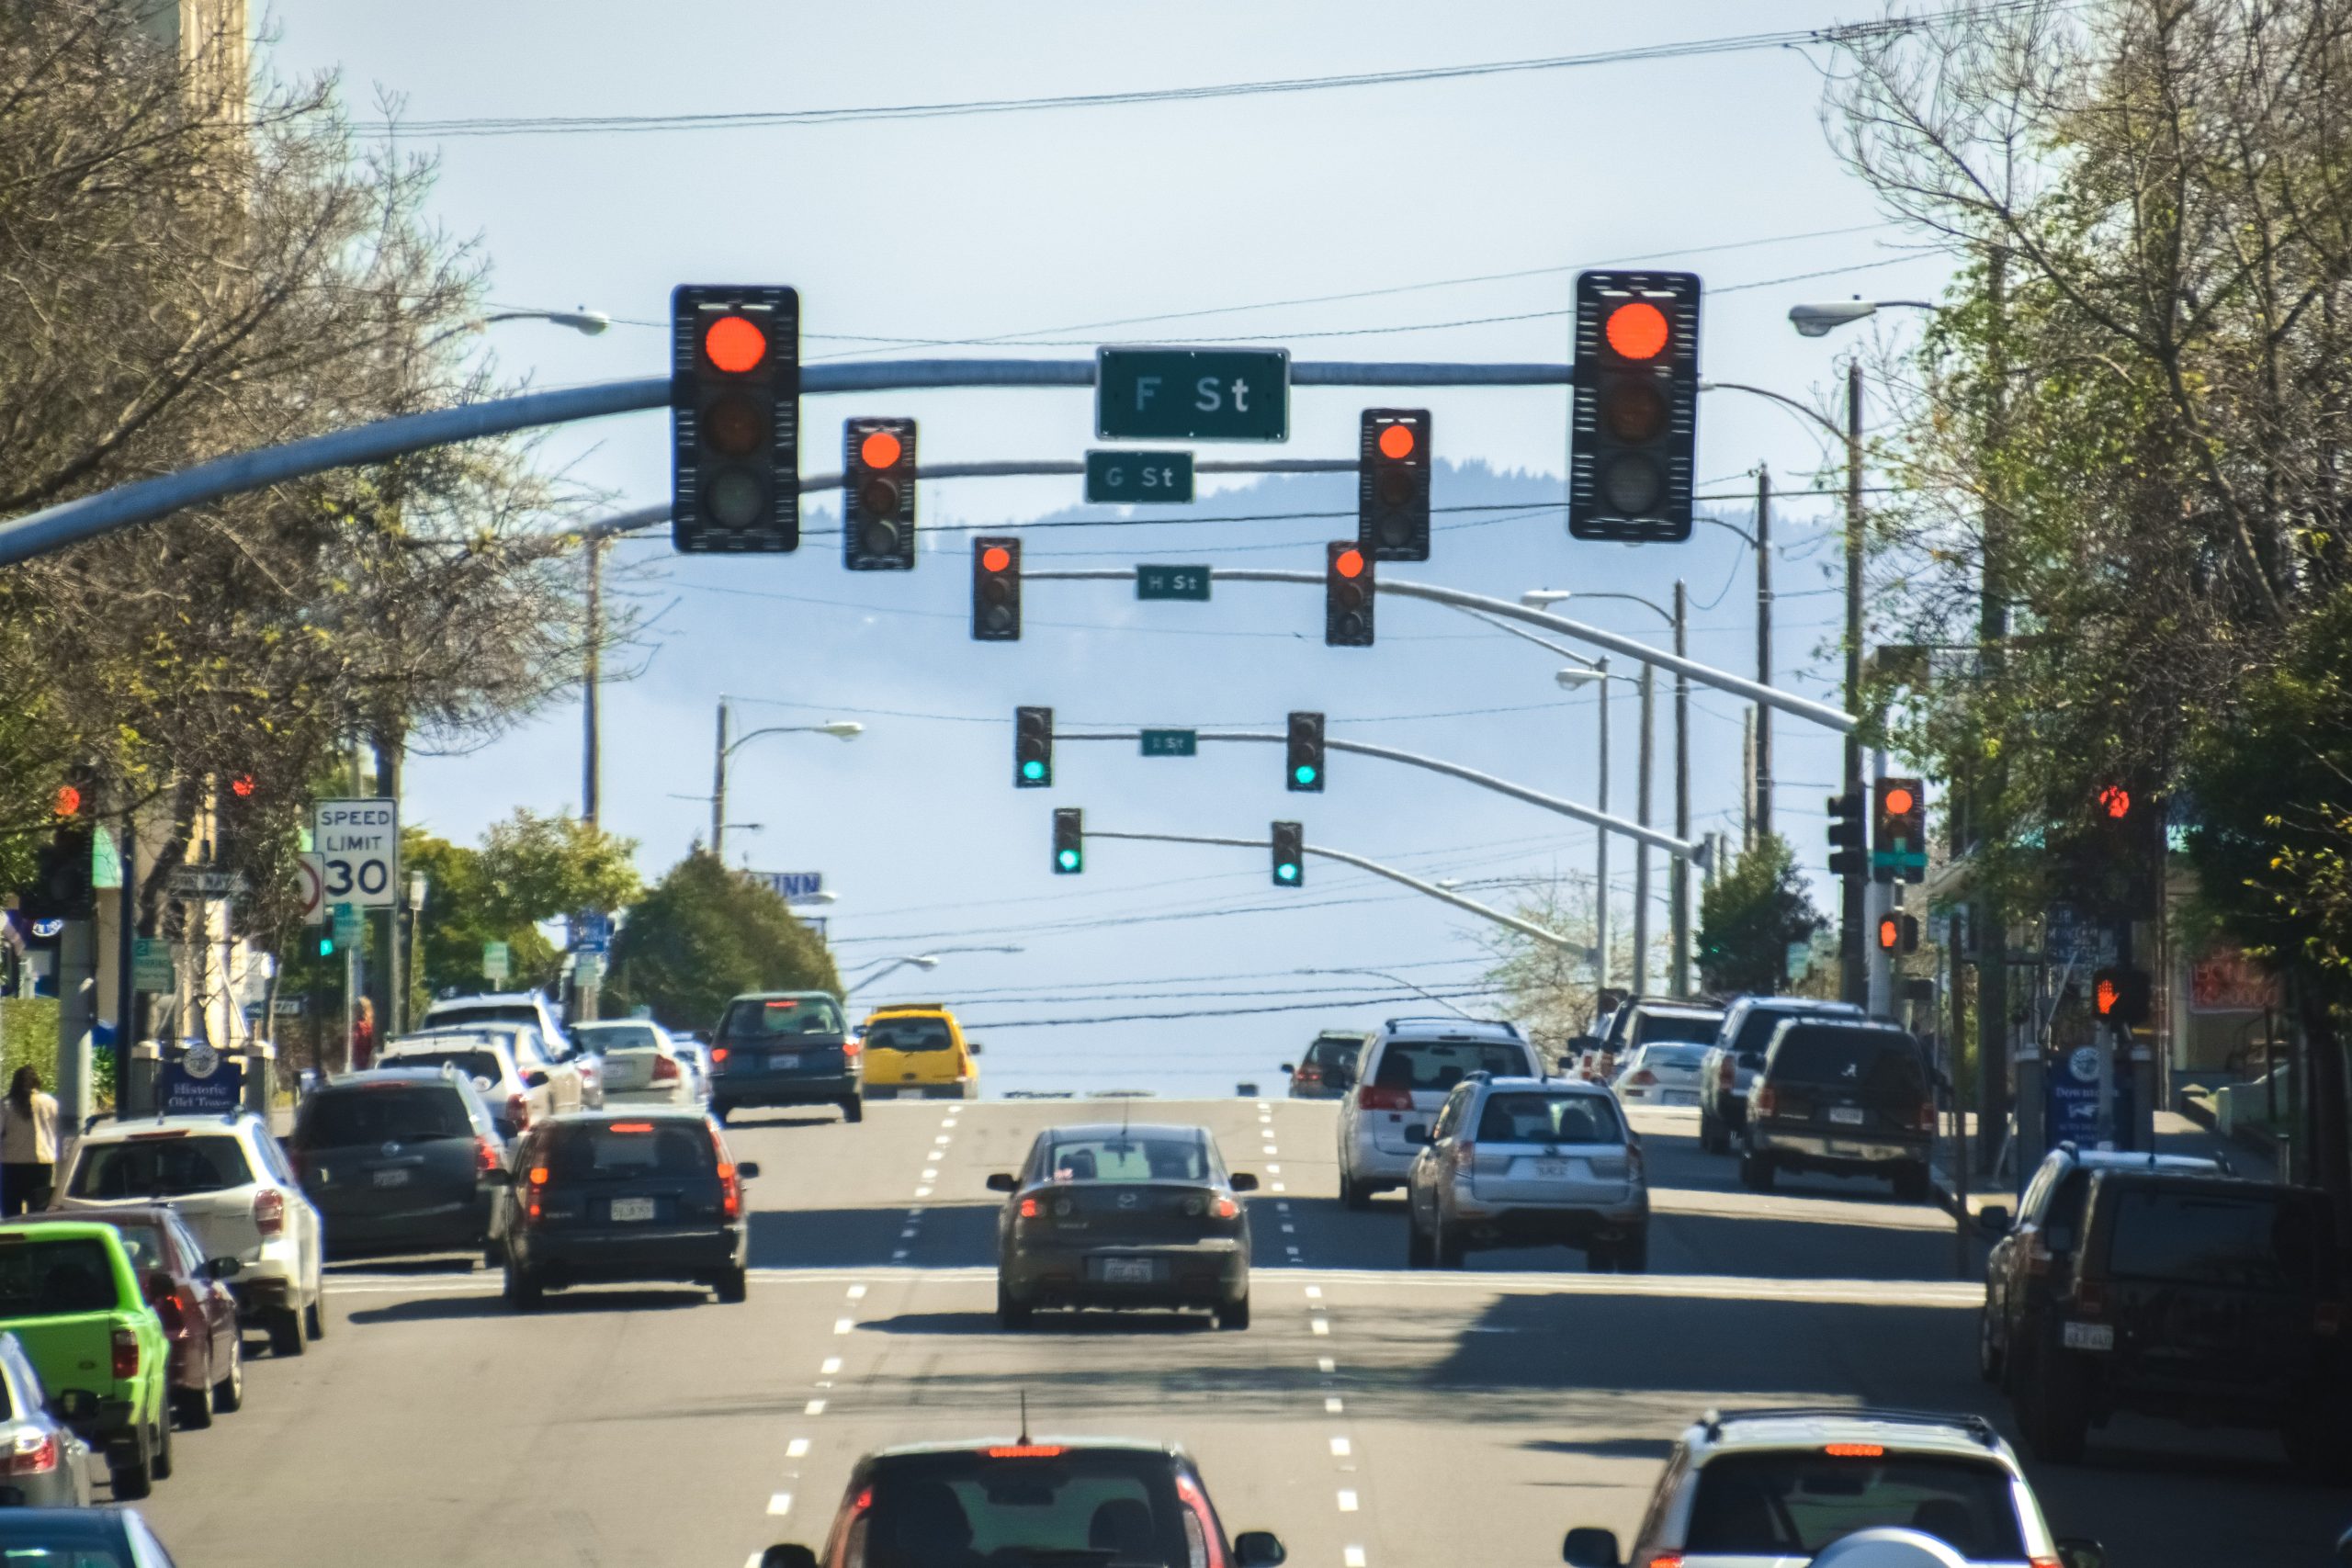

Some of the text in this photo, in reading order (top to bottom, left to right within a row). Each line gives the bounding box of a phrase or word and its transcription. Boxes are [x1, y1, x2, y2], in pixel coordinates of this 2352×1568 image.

[1136, 376, 1250, 412] F St
[1105, 467, 1173, 488] G St
[1148, 575, 1197, 591] H St
[1165, 737, 1184, 750] St
[321, 810, 390, 826] SPEED
[326, 835, 382, 852] LIMIT
[324, 859, 388, 897] 30
[173, 1082, 227, 1095] Historic
